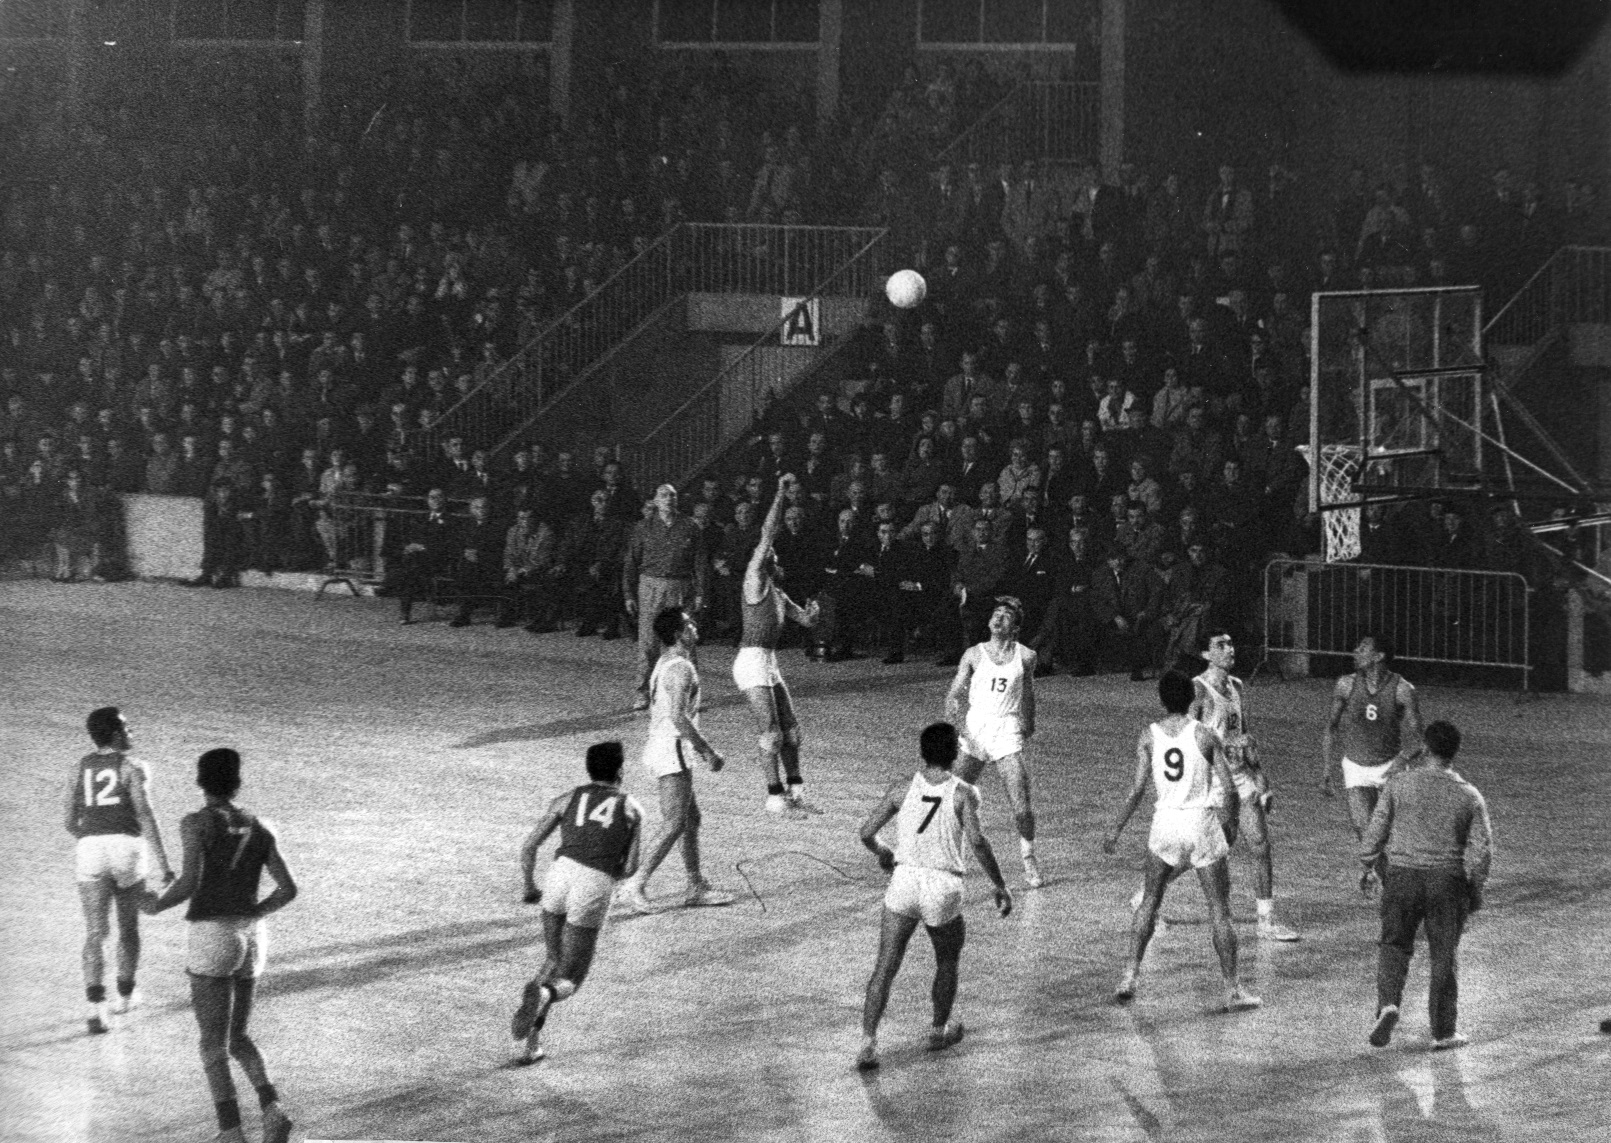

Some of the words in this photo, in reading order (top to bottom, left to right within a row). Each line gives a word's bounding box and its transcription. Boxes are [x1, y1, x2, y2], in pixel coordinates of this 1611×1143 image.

[786, 302, 815, 341] A
[991, 677, 1008, 692] 13
[1365, 703, 1378, 720] 6
[1163, 747, 1184, 782] 9
[84, 768, 120, 806] 12
[575, 792, 618, 829] 14
[917, 795, 942, 834] 7
[228, 826, 252, 870] 7
